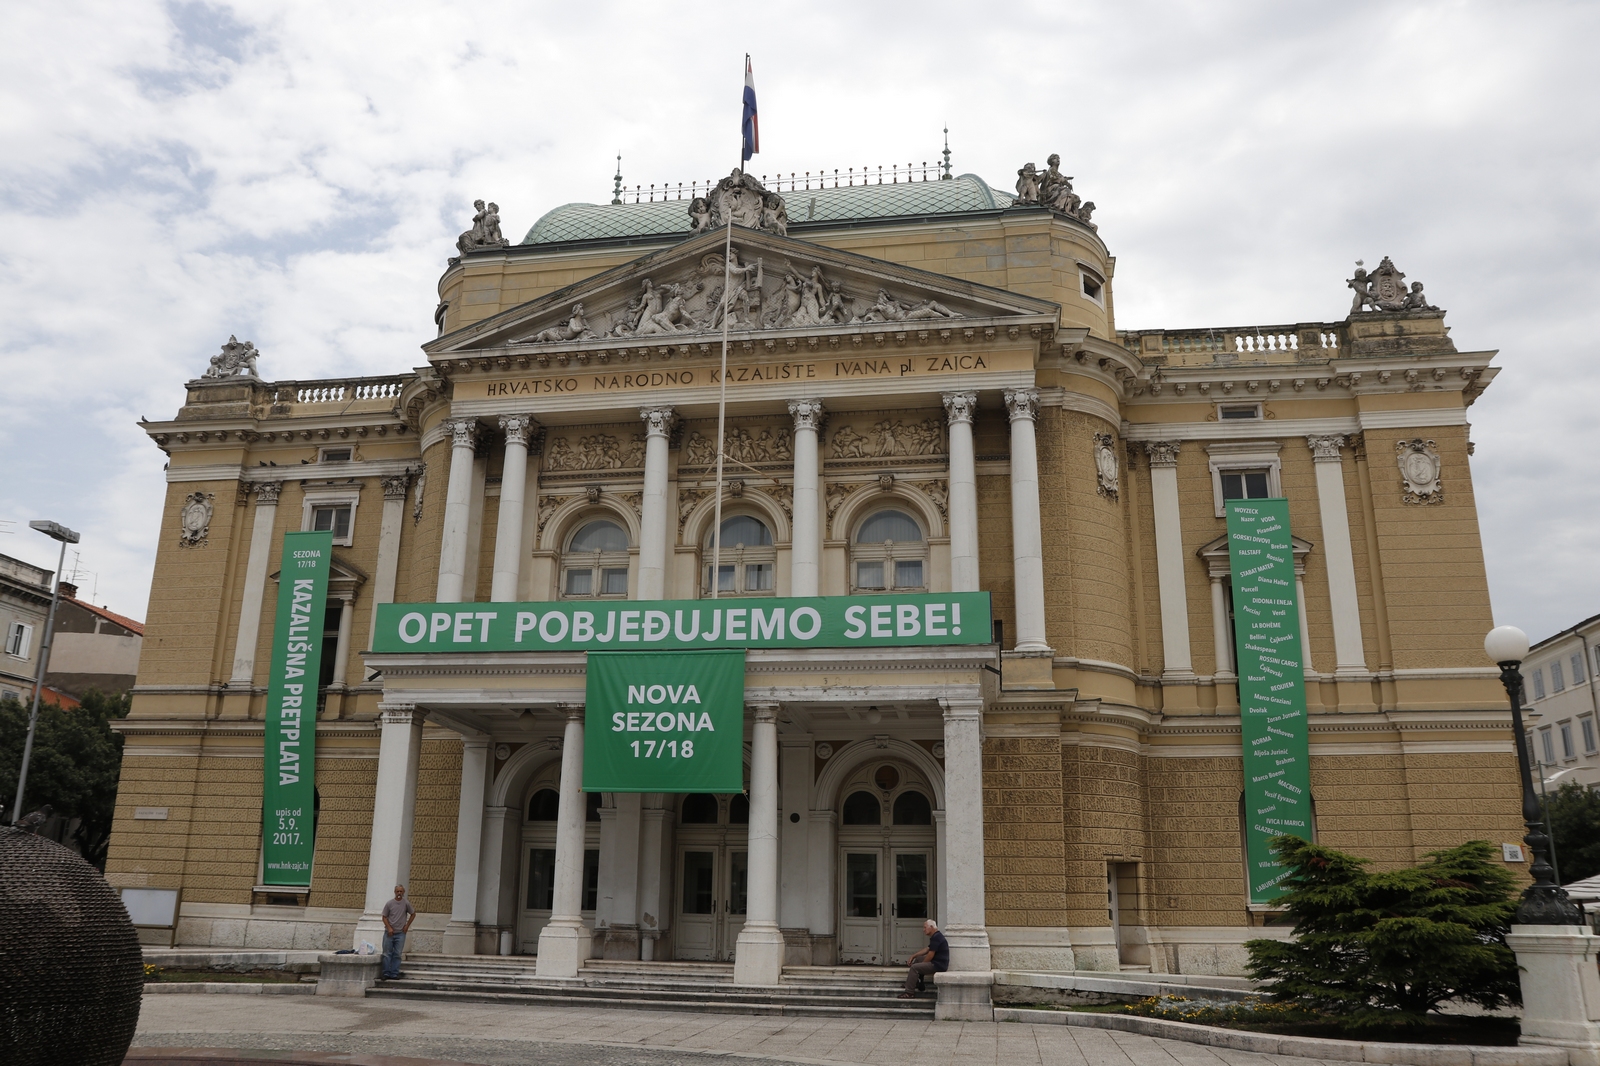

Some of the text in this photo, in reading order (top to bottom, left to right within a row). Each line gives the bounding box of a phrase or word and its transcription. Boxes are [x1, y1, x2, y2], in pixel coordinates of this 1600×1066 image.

[487, 378, 578, 396] HRVATSKO
[593, 371, 694, 390] NARODNO
[710, 363, 816, 383] KAZALIŠTE
[835, 360, 892, 376] IVANA
[926, 355, 987, 372] ZAJCA
[1260, 515, 1276, 523] VODA
[1256, 524, 1282, 534] Pirandello
[1232, 533, 1271, 544] GORSKI DIVOVI
[293, 550, 321, 559] SEZONA
[1266, 553, 1285, 563] Rossini
[298, 560, 316, 568] 17/18
[1240, 562, 1274, 577] STABAT MATER
[1258, 576, 1273, 584] Diana
[1243, 605, 1261, 616] Puccini
[399, 603, 962, 643] OPET POBJEĐUJEMO SEBE!
[1269, 633, 1293, 644] Čajkovski
[1245, 643, 1277, 653] Shakespeare
[1259, 655, 1298, 668] ROSSINI CARDS
[279, 579, 314, 786] KAZALIŠNA PRETPLATA
[1270, 681, 1295, 692] REQUIEM
[628, 685, 701, 704] NOVA
[1254, 693, 1292, 705] Marco Graziani
[612, 712, 715, 732] SEZONA
[1267, 715, 1282, 723] Zoran
[1267, 725, 1294, 738] Beethoven
[1251, 736, 1272, 746] NORMA
[630, 739, 694, 759] 17/18
[1275, 757, 1296, 766] Brahms
[1252, 769, 1286, 783] Marco Boemi
[1278, 779, 1302, 794] MACBETH
[1264, 790, 1298, 804] Yusif Eyvazov
[276, 808, 302, 817] upis od
[1257, 804, 1276, 815] Rossini
[279, 818, 298, 830] 5.9.
[1284, 819, 1305, 827] MARICA
[1254, 824, 1274, 835] GLAZBE
[273, 832, 303, 845] 2017.
[267, 861, 309, 871] www.hnk-zajc.hr
